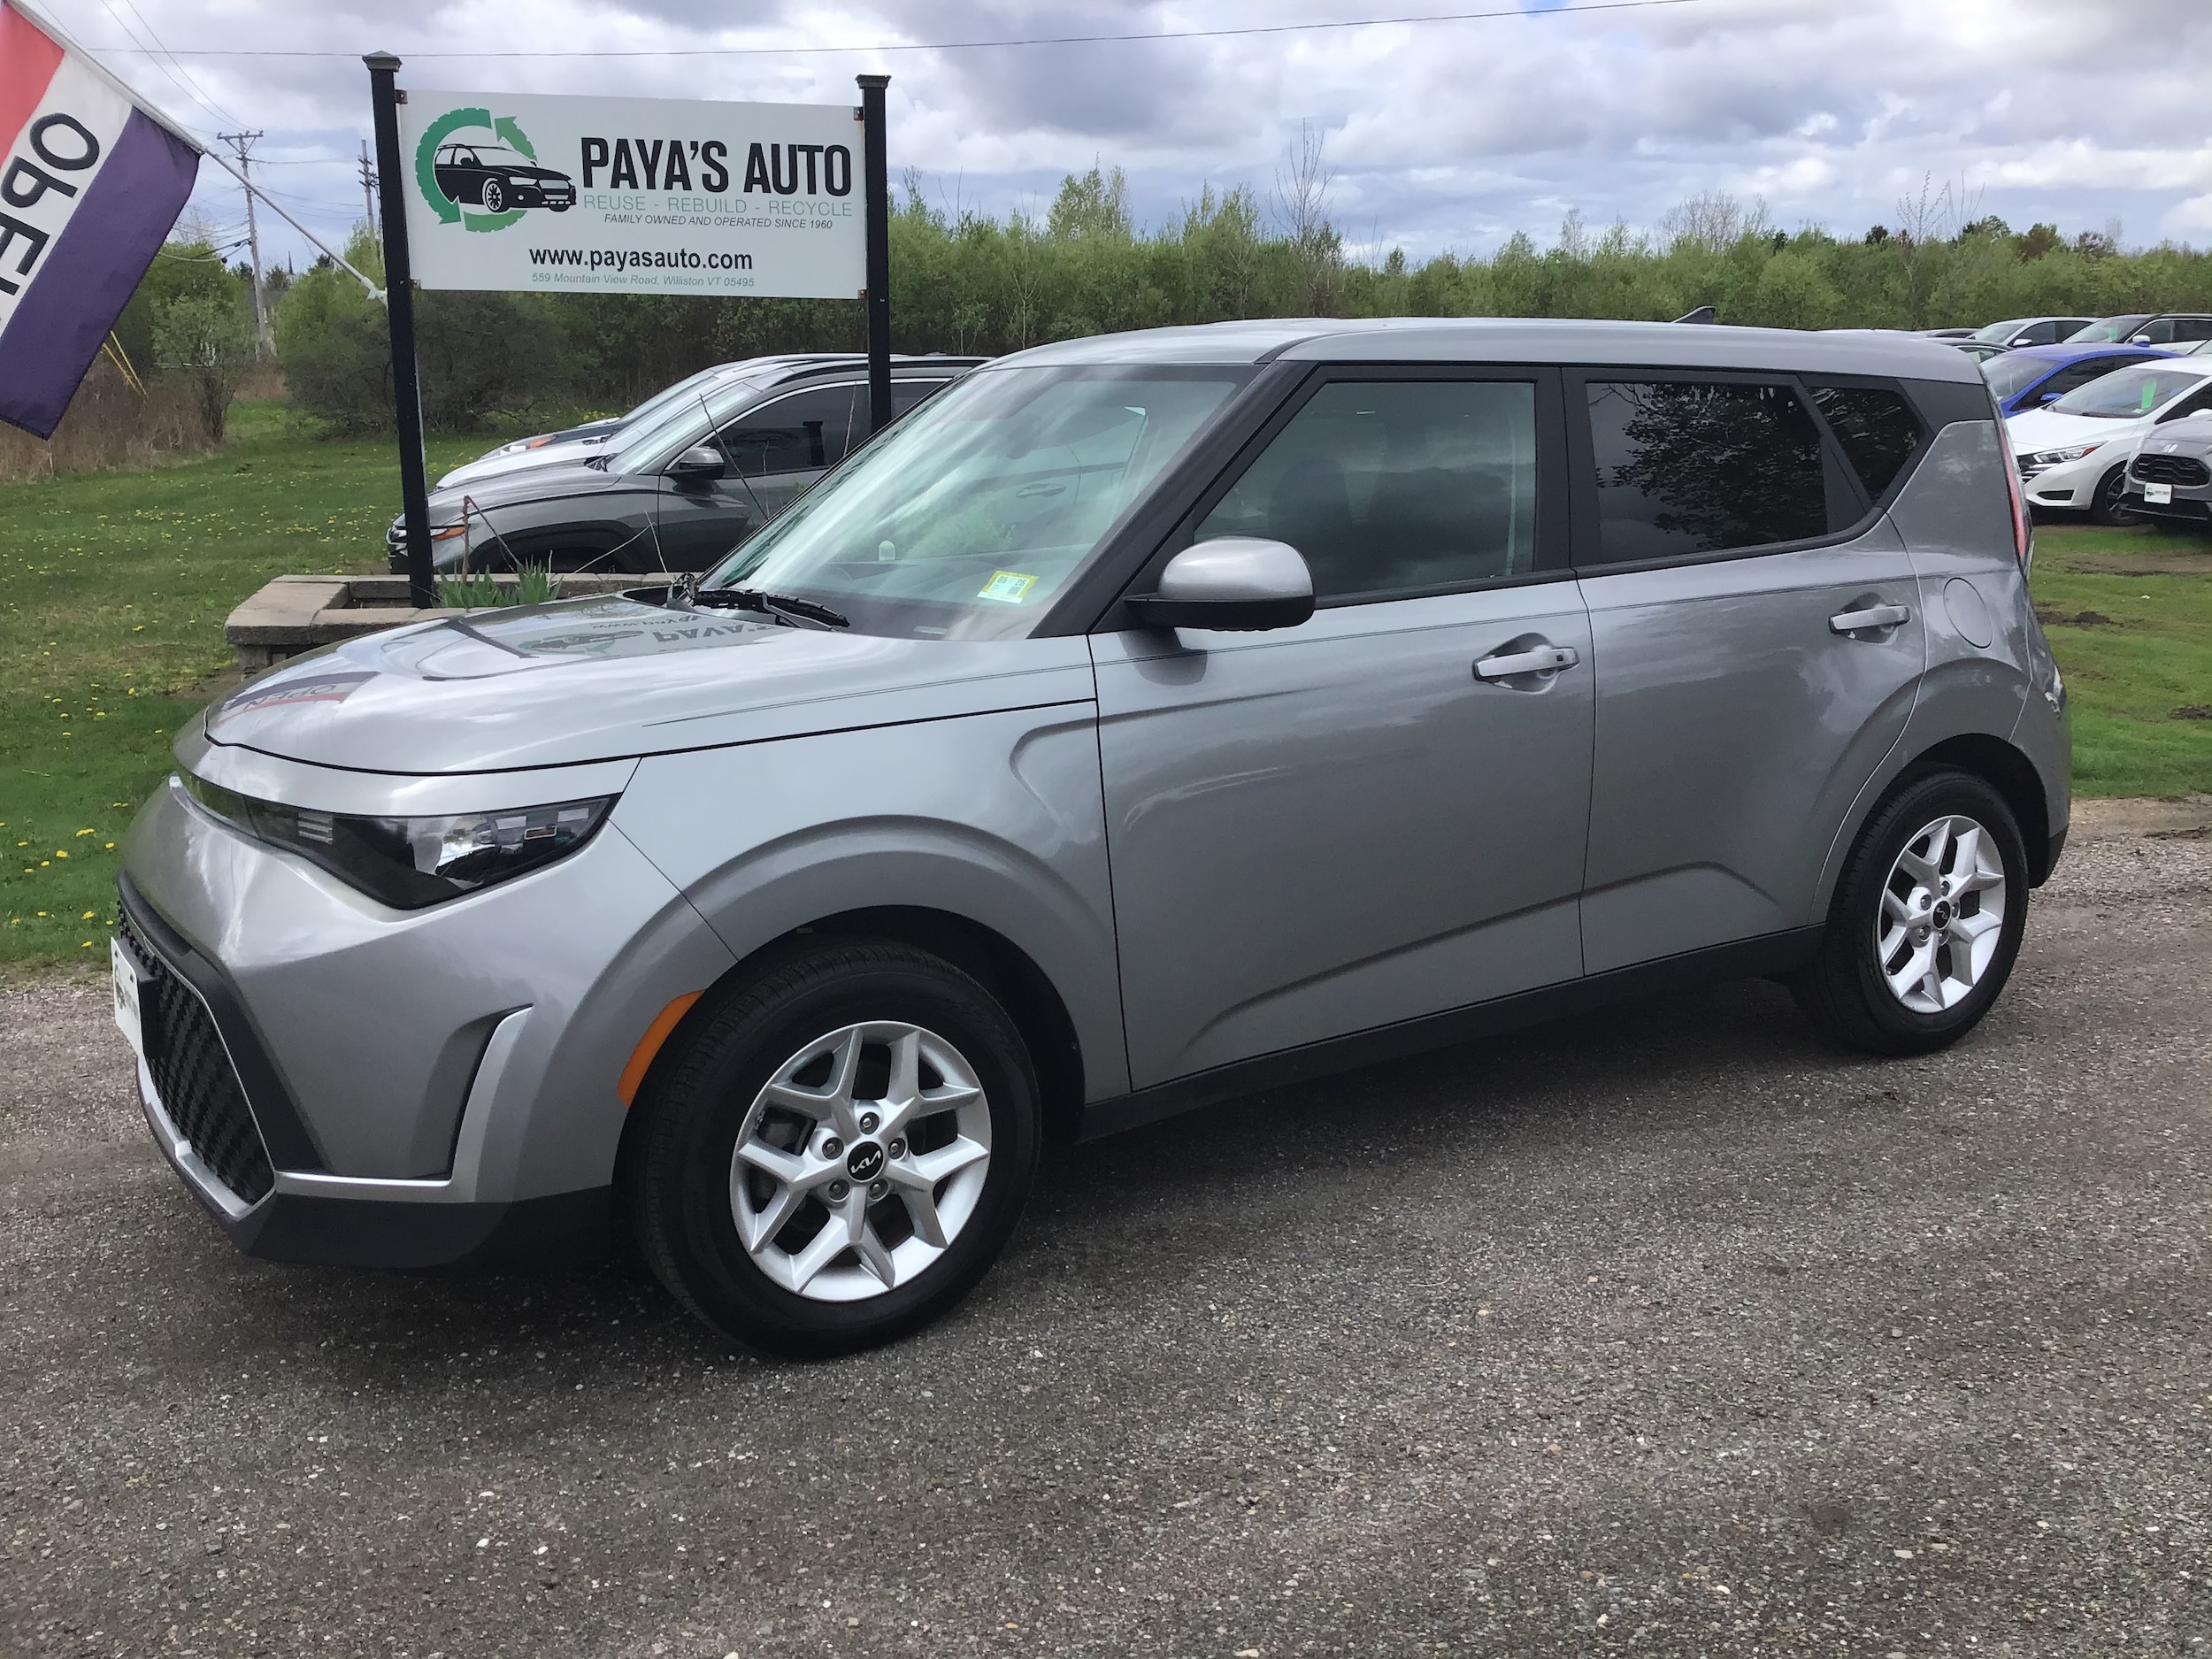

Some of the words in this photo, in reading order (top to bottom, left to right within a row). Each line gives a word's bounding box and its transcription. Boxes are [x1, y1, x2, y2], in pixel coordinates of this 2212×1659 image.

[581, 137, 729, 193] PAYA'S
[743, 142, 851, 196] AUTO
[584, 195, 646, 211] REUSE
[668, 196, 747, 213] REBUILD
[769, 200, 852, 217] RECYCLE
[604, 213, 642, 224] FAMILY
[645, 214, 686, 226] OWNED
[688, 216, 711, 226] AND
[714, 216, 772, 227] OPERATED
[774, 218, 807, 228] SINCE
[810, 219, 833, 229] 1960
[528, 248, 753, 273] www.payasauto.com
[532, 273, 551, 282] 559
[554, 273, 600, 283] Mountain
[603, 274, 628, 284] View
[663, 275, 704, 286] Williston
[707, 276, 721, 286] VT
[723, 277, 755, 288] 05495
